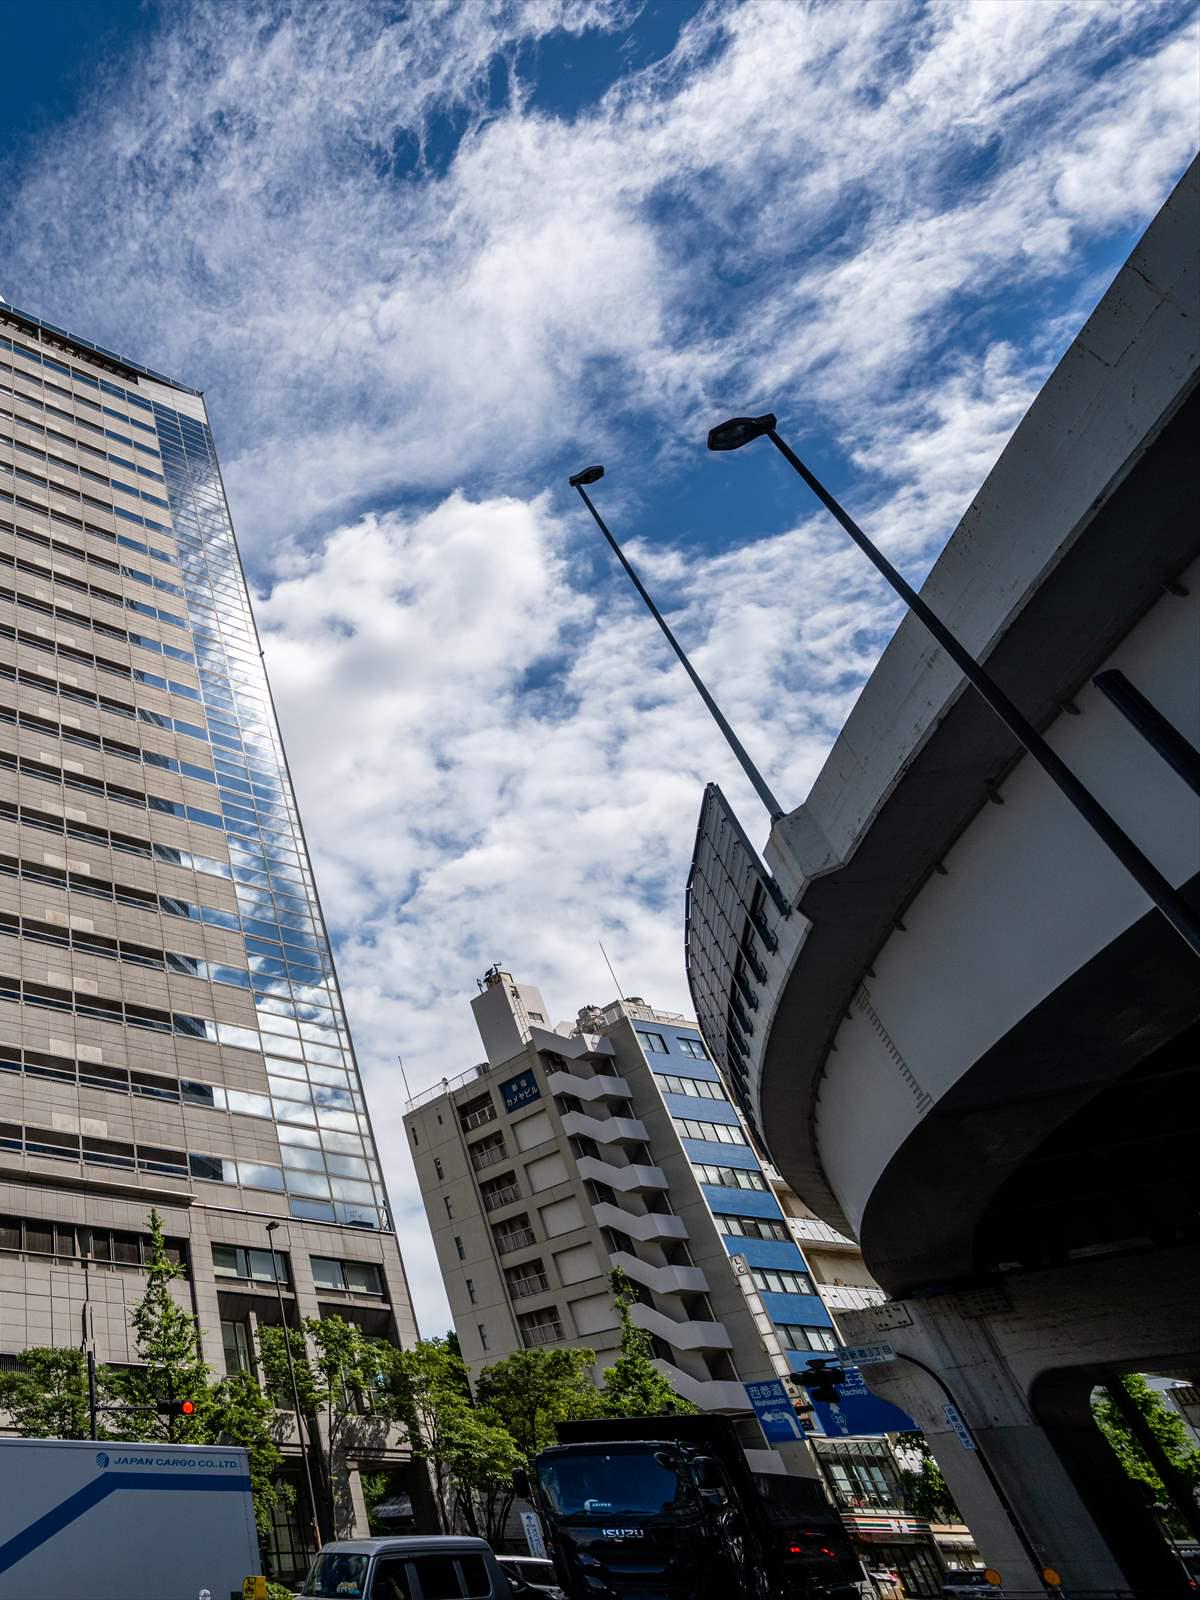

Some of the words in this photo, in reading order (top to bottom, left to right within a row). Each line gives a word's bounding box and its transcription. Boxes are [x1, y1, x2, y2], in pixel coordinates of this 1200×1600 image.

[835, 1415, 845, 1424] 20
[114, 1456, 153, 1466] JAPAN
[155, 1458, 196, 1467] CARGO
[602, 1529, 644, 1538] ISUZU
